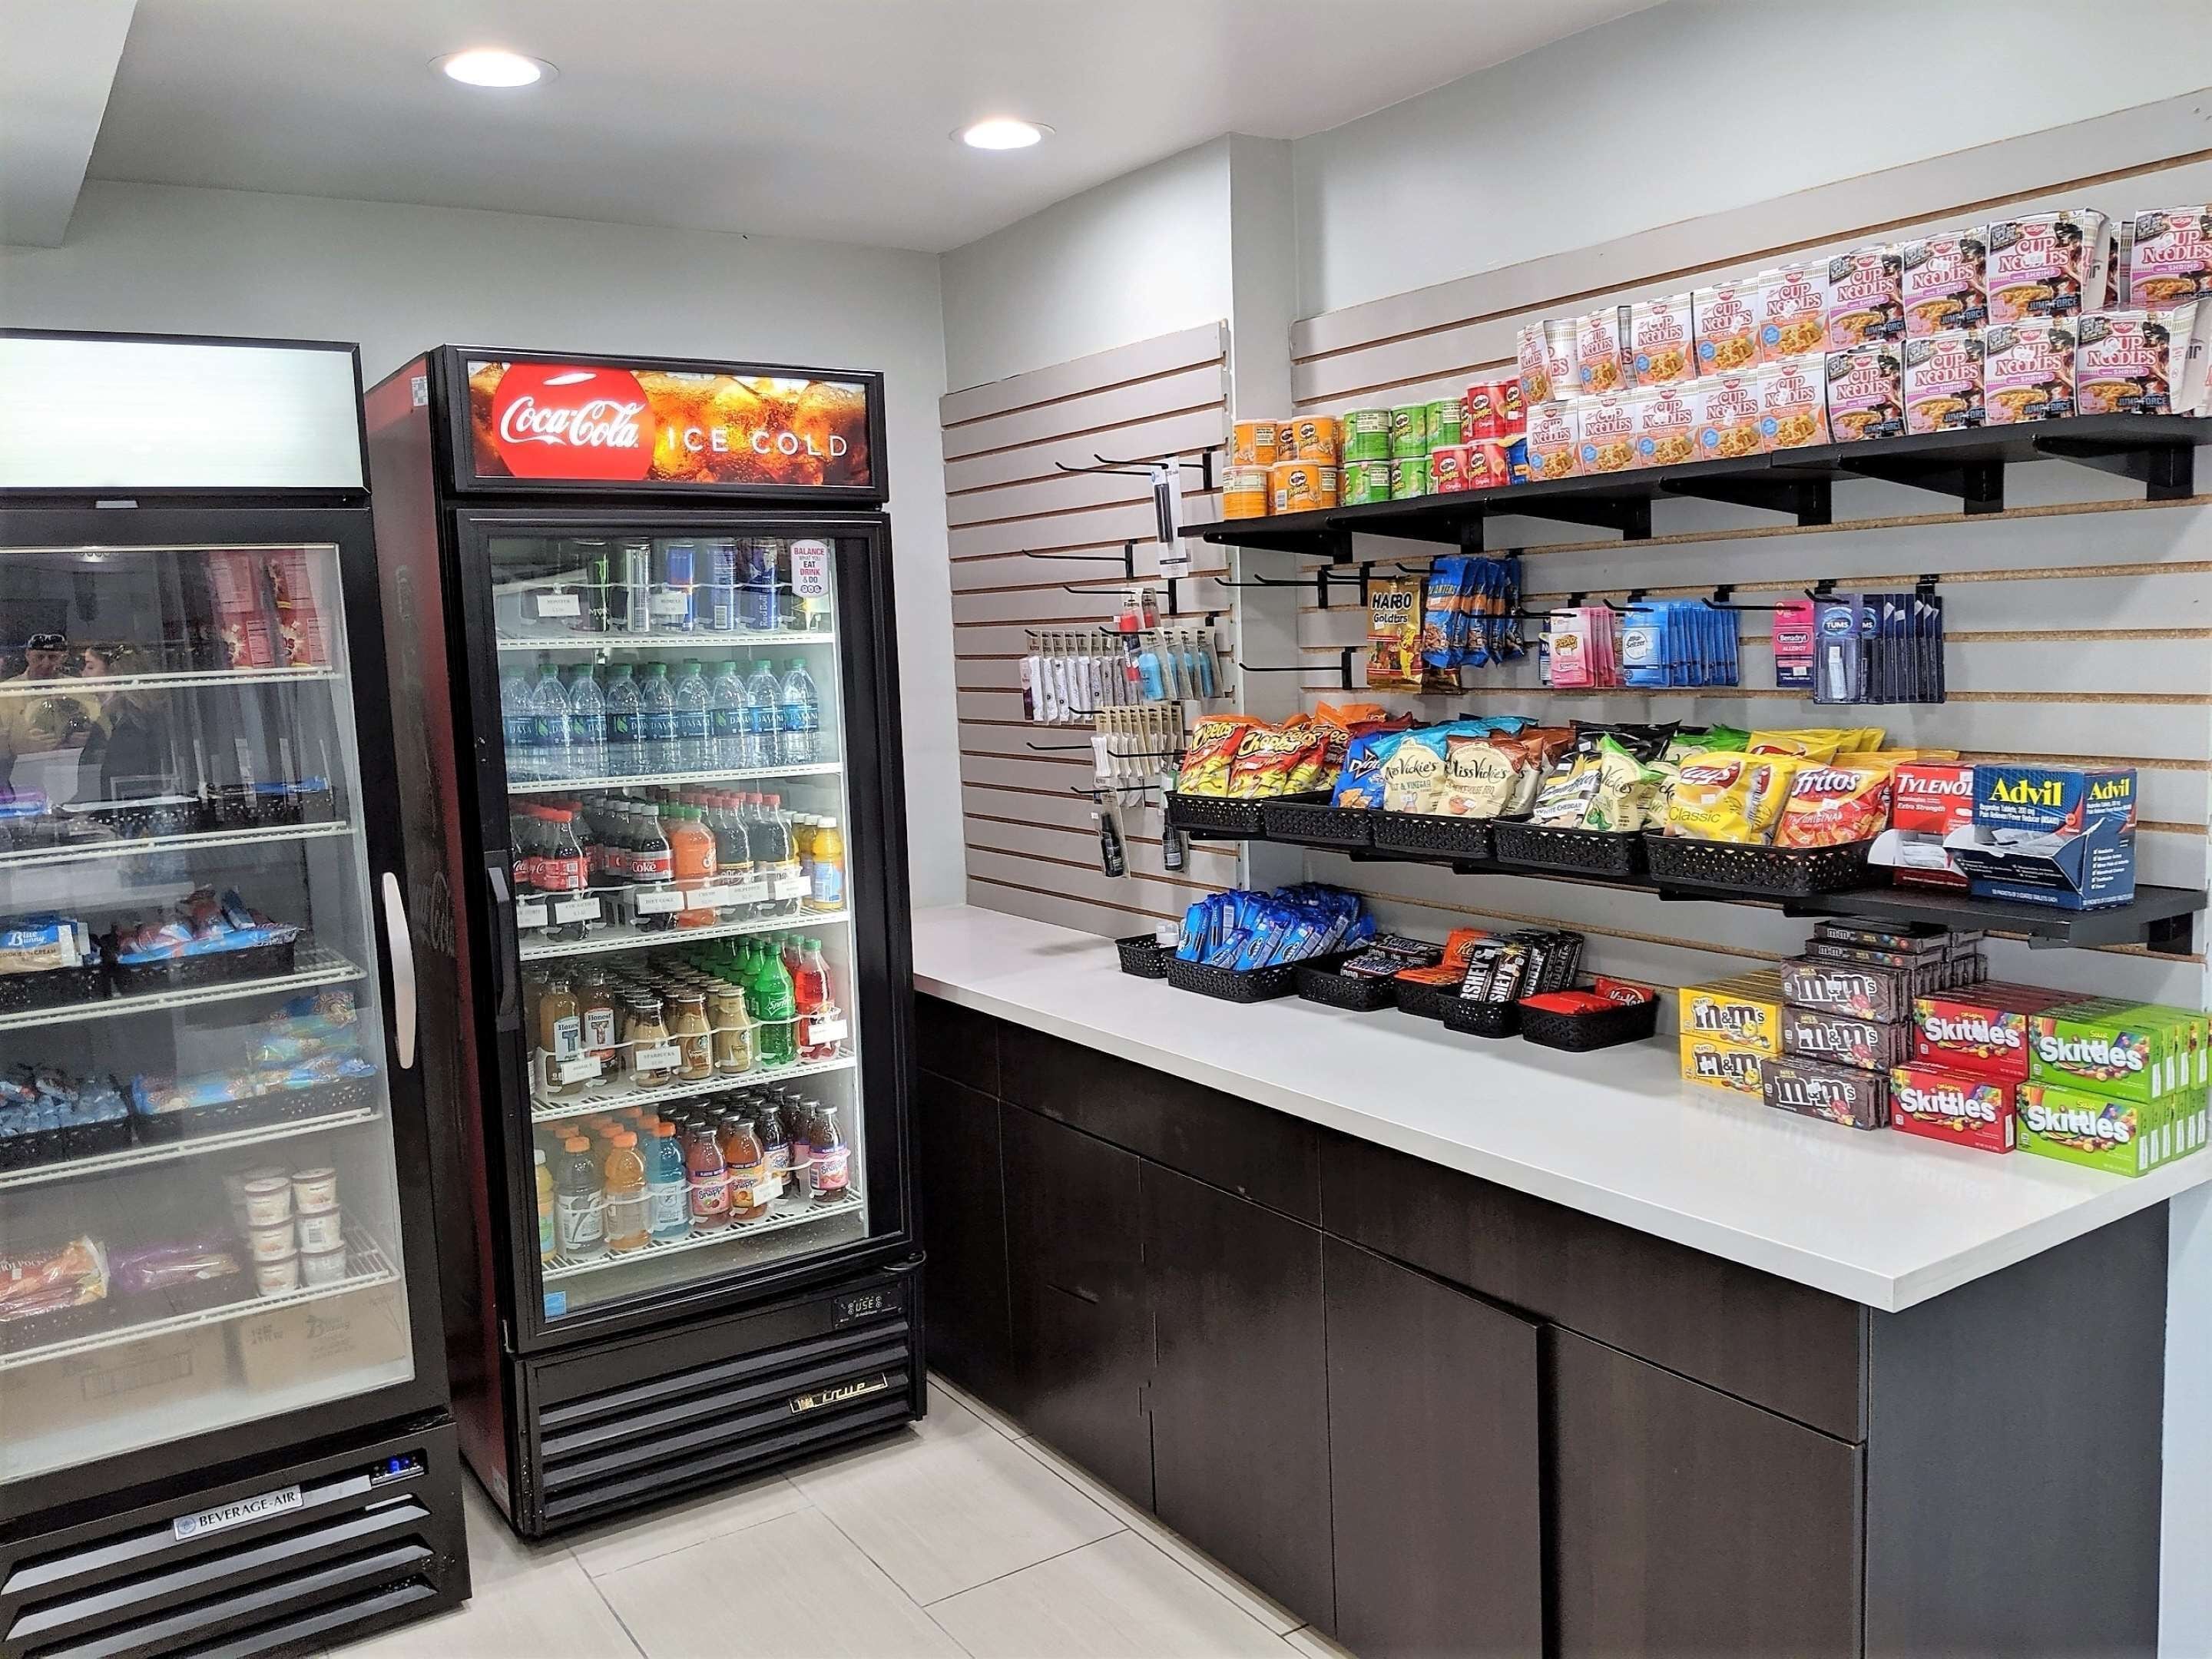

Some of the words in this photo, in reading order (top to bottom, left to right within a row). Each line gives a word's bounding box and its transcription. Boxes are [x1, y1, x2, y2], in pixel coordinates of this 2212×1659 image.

[2015, 237, 2057, 256] CUP
[2160, 230, 2201, 250] UP
[1998, 250, 2071, 273] NOLES
[1851, 267, 1883, 285] CUP
[1912, 264, 1975, 289] NOODLES
[1780, 283, 1812, 300] CUP
[1837, 278, 1896, 302] NOODLES
[1713, 300, 1741, 317] CUP
[1767, 293, 1823, 316] NODLES
[1702, 310, 1753, 333] NOODS
[1638, 325, 1684, 346] NOODLES
[1929, 353, 1967, 370] CUP
[1997, 355, 2064, 376] NOODLES
[2088, 349, 2157, 368] NOODLES
[1776, 376, 1805, 392] CUP
[1849, 368, 1880, 385] CUP
[1915, 363, 1979, 386] NOODLES
[1718, 389, 1747, 406] CUP
[1765, 386, 1816, 408] NODLES
[1836, 379, 1892, 400] NOODLES
[1654, 400, 1683, 415] CUP
[1968, 408, 1985, 419] FORC
[500, 396, 645, 449] Coca-Cola
[1586, 417, 1632, 436] NOODLES
[669, 427, 729, 453] ICE
[750, 431, 848, 458] COLD
[1533, 428, 1570, 445] NOODLES
[793, 547, 825, 556] BALANCE
[1826, 621, 1849, 629] TUMS
[1779, 634, 1807, 643] Benadryl
[1399, 755, 1438, 778] Vickie's
[1472, 757, 1508, 783] Vickie's
[1407, 780, 1431, 789] VINEGAR
[1792, 768, 1861, 799] Fritos
[1896, 774, 1974, 796] TYLENOL
[1988, 777, 2062, 806] Advil
[2088, 778, 2131, 801] Advil
[1557, 803, 1582, 811] CHEDDAR
[1668, 806, 1721, 823] Classic
[1916, 803, 1946, 813] Strength
[632, 860, 657, 873] Coke
[1460, 948, 1490, 1002] RSHEY'S
[587, 1013, 611, 1022] Honest
[1694, 1004, 1766, 1031] m&m's
[561, 1029, 578, 1052] T
[591, 1021, 609, 1045] T
[1795, 1022, 1878, 1051] m&m's
[1923, 1017, 2022, 1048] Skittles
[2088, 1030, 2110, 1041] Sour
[2039, 1036, 2144, 1072] Skittles
[1899, 1088, 1997, 1122] Skittles
[2076, 1100, 2098, 1111] Sour
[2026, 1104, 2131, 1144] Skittles
[199, 1491, 296, 1528] BEVERAGE-AIR
